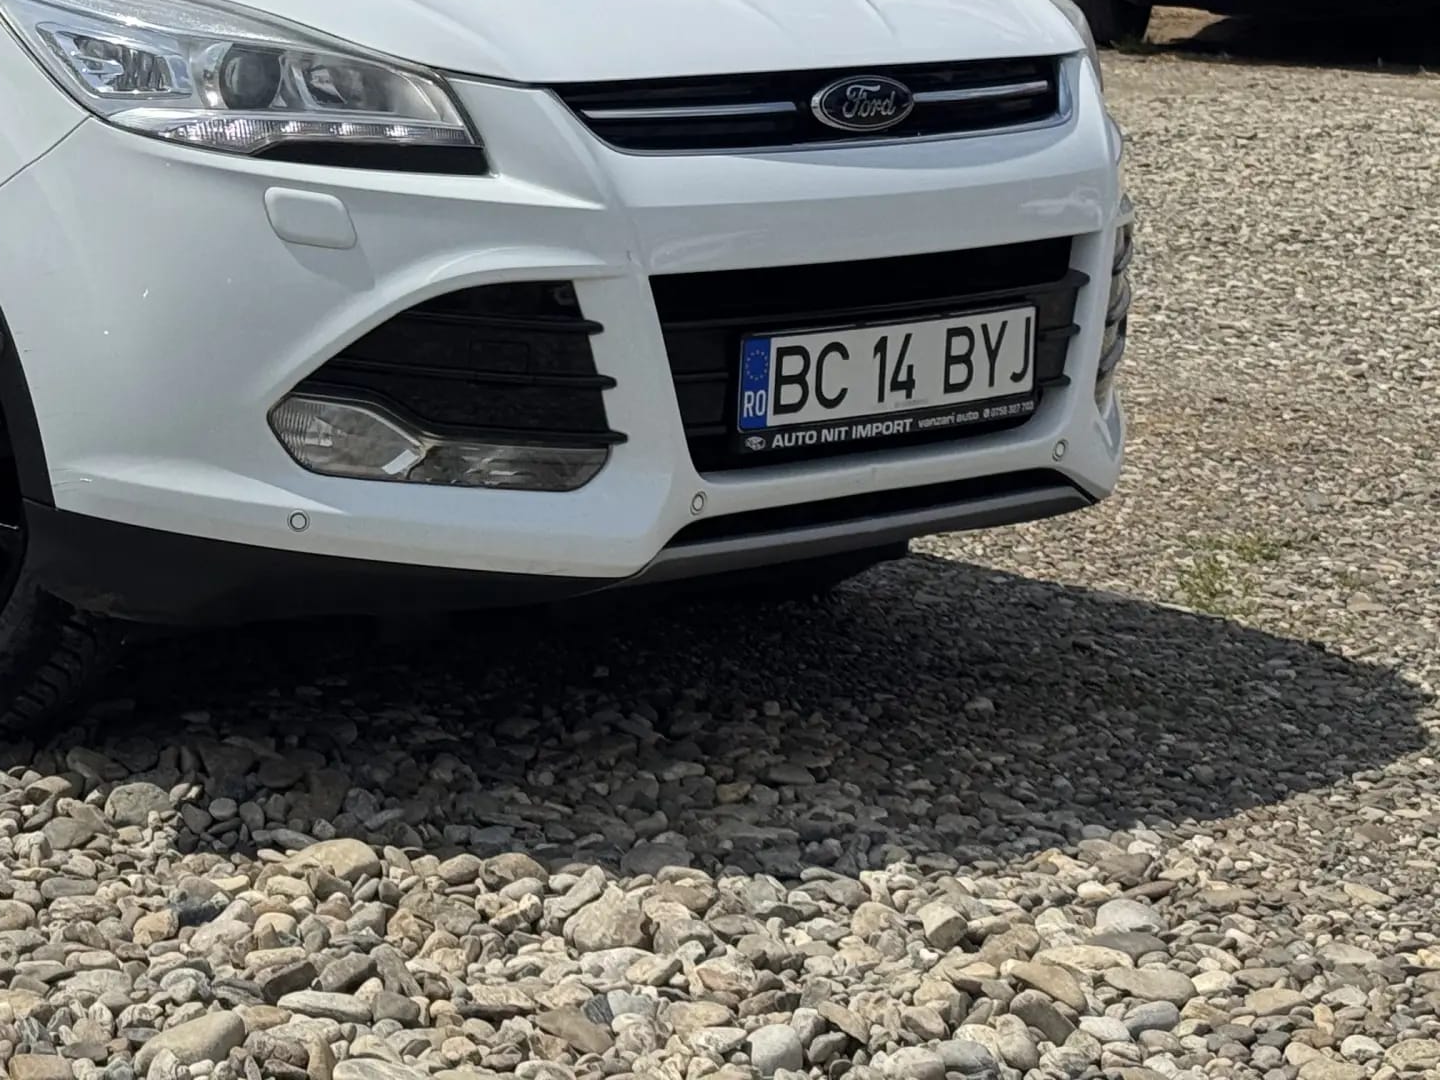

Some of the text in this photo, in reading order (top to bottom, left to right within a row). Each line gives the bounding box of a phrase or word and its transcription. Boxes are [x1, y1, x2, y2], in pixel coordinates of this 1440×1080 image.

[841, 84, 896, 119] Ford
[772, 316, 1032, 416] BC 14 BYJ
[743, 391, 766, 418] RO
[771, 430, 817, 449] AUTO
[821, 427, 848, 443] NIT
[851, 419, 913, 439] IMPORT
[956, 411, 979, 423] auto
